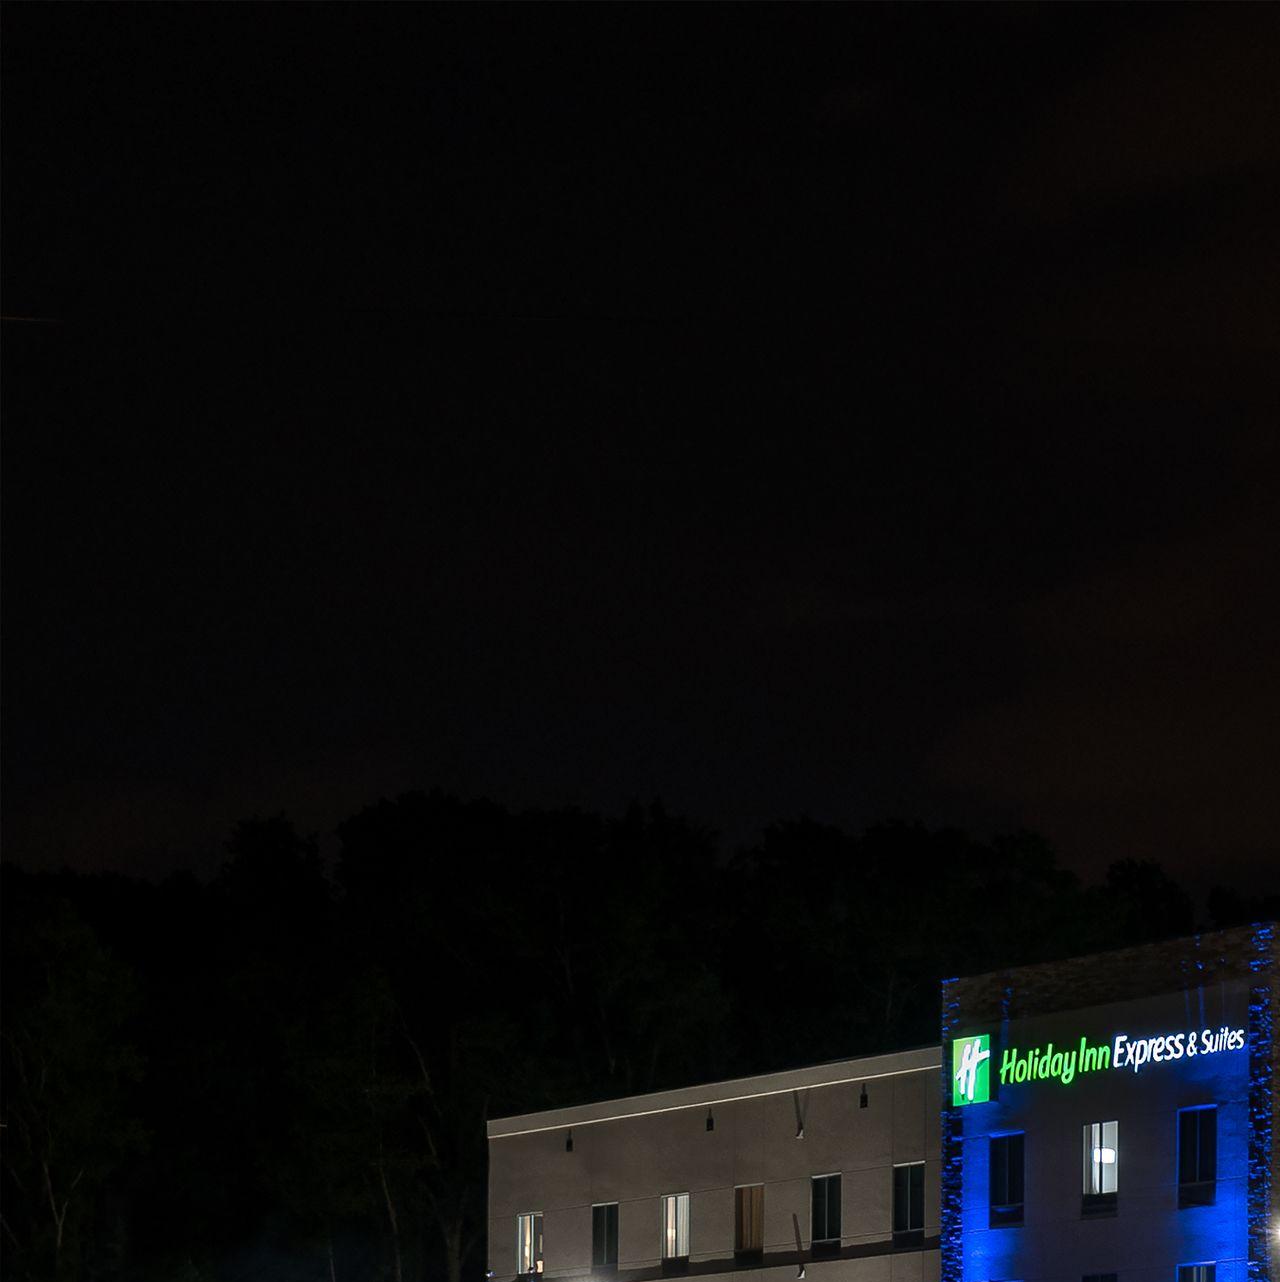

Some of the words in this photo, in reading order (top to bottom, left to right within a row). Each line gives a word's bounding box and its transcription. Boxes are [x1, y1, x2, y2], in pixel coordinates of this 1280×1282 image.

[1000, 1043, 1078, 1085] Holiday
[1079, 1037, 1110, 1074] Inn
[1113, 1033, 1185, 1073] Express
[1187, 1032, 1197, 1057] &
[1201, 1026, 1245, 1054] Suites
